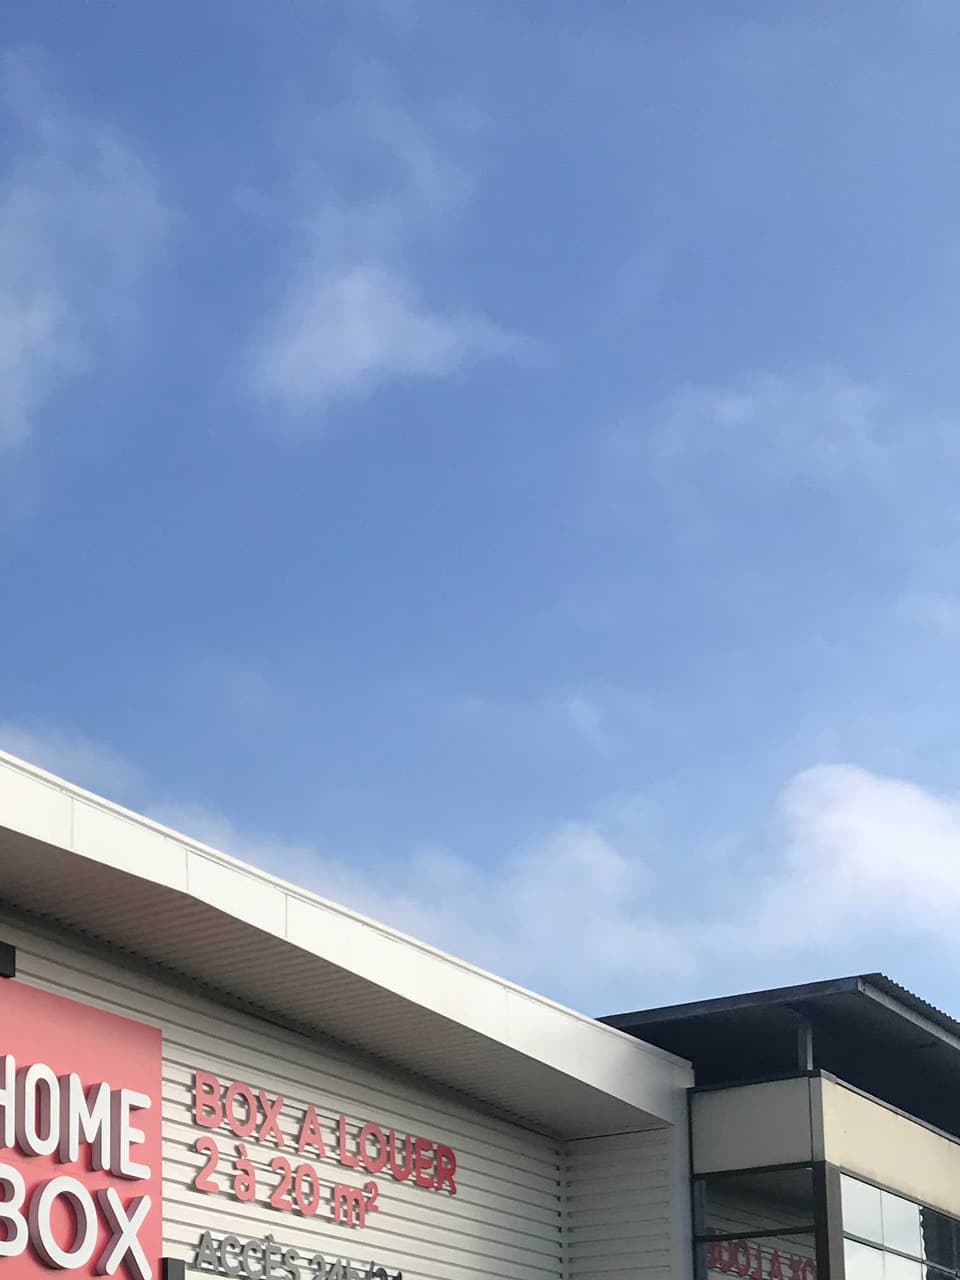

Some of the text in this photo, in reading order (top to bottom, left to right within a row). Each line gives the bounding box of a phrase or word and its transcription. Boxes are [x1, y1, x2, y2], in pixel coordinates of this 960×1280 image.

[194, 1070, 457, 1195] BOX A LOUER
[194, 1136, 220, 1194] 2
[233, 1144, 256, 1203] à
[270, 1157, 320, 1217] 20
